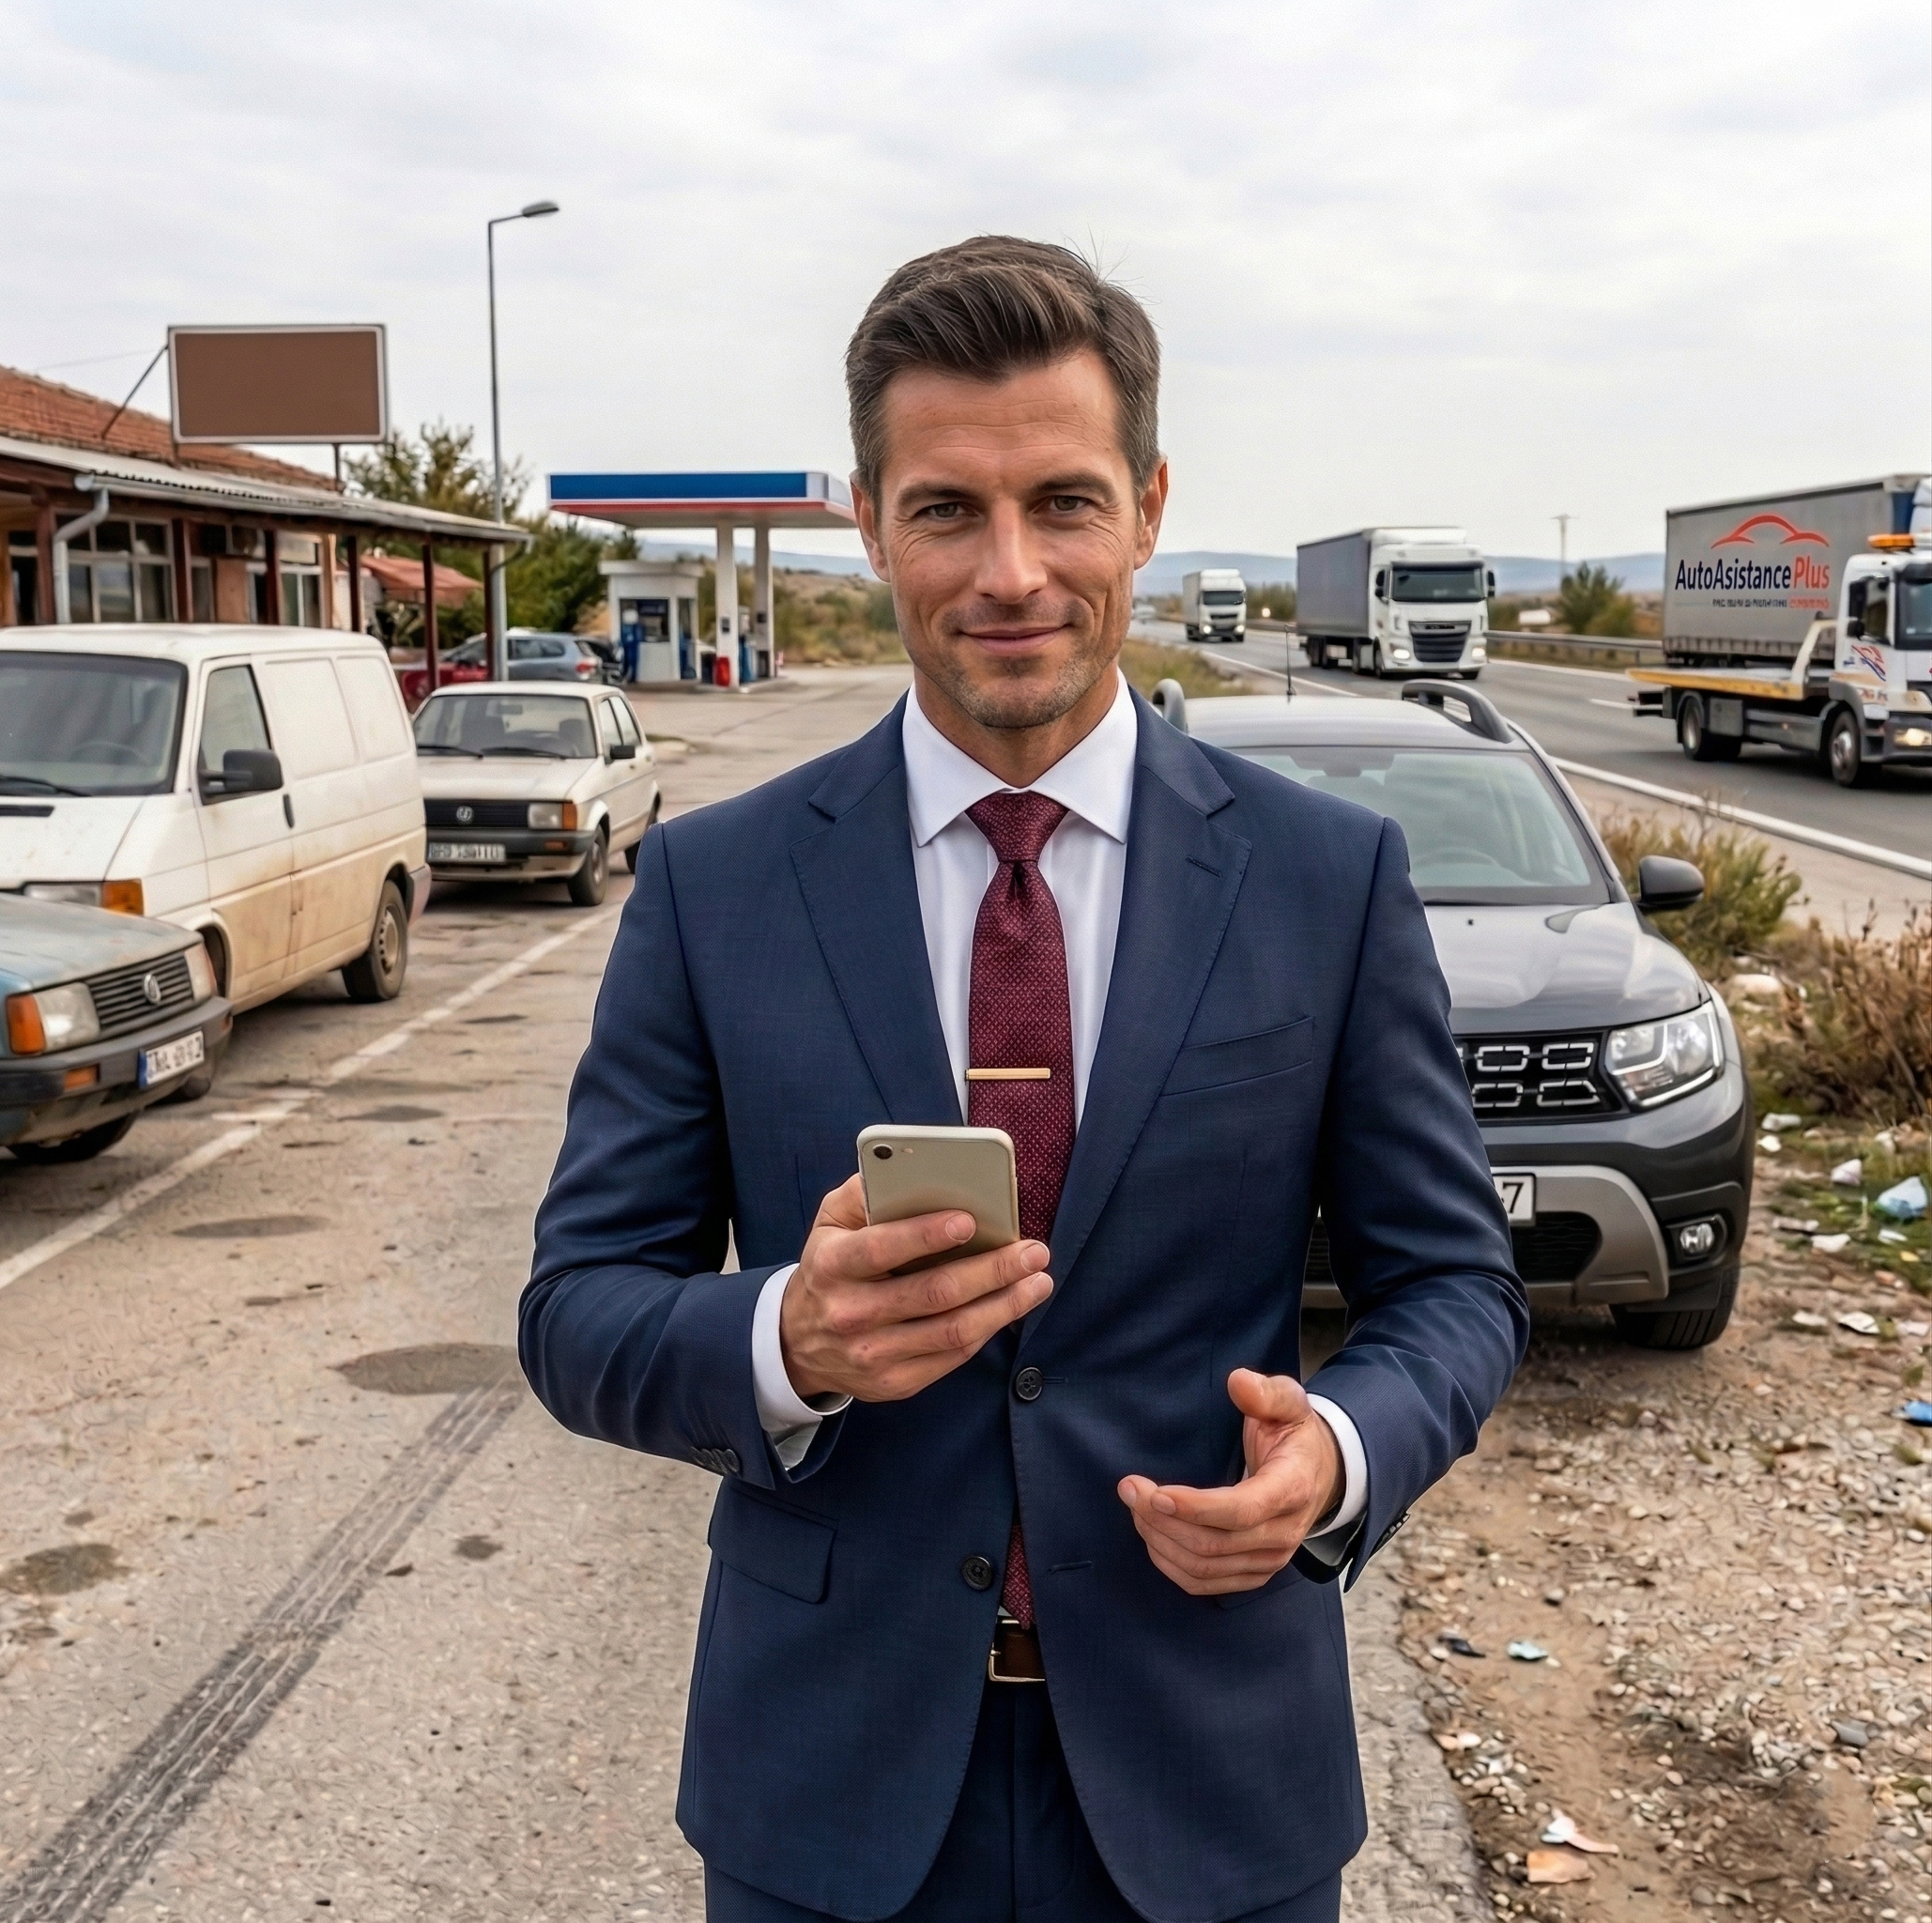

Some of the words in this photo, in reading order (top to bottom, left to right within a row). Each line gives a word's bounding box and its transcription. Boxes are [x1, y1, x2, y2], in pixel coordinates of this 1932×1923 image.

[1675, 558, 1791, 590] AutoAsistance
[1793, 556, 1830, 589] Plus
[1501, 1182, 1524, 1213] 7
